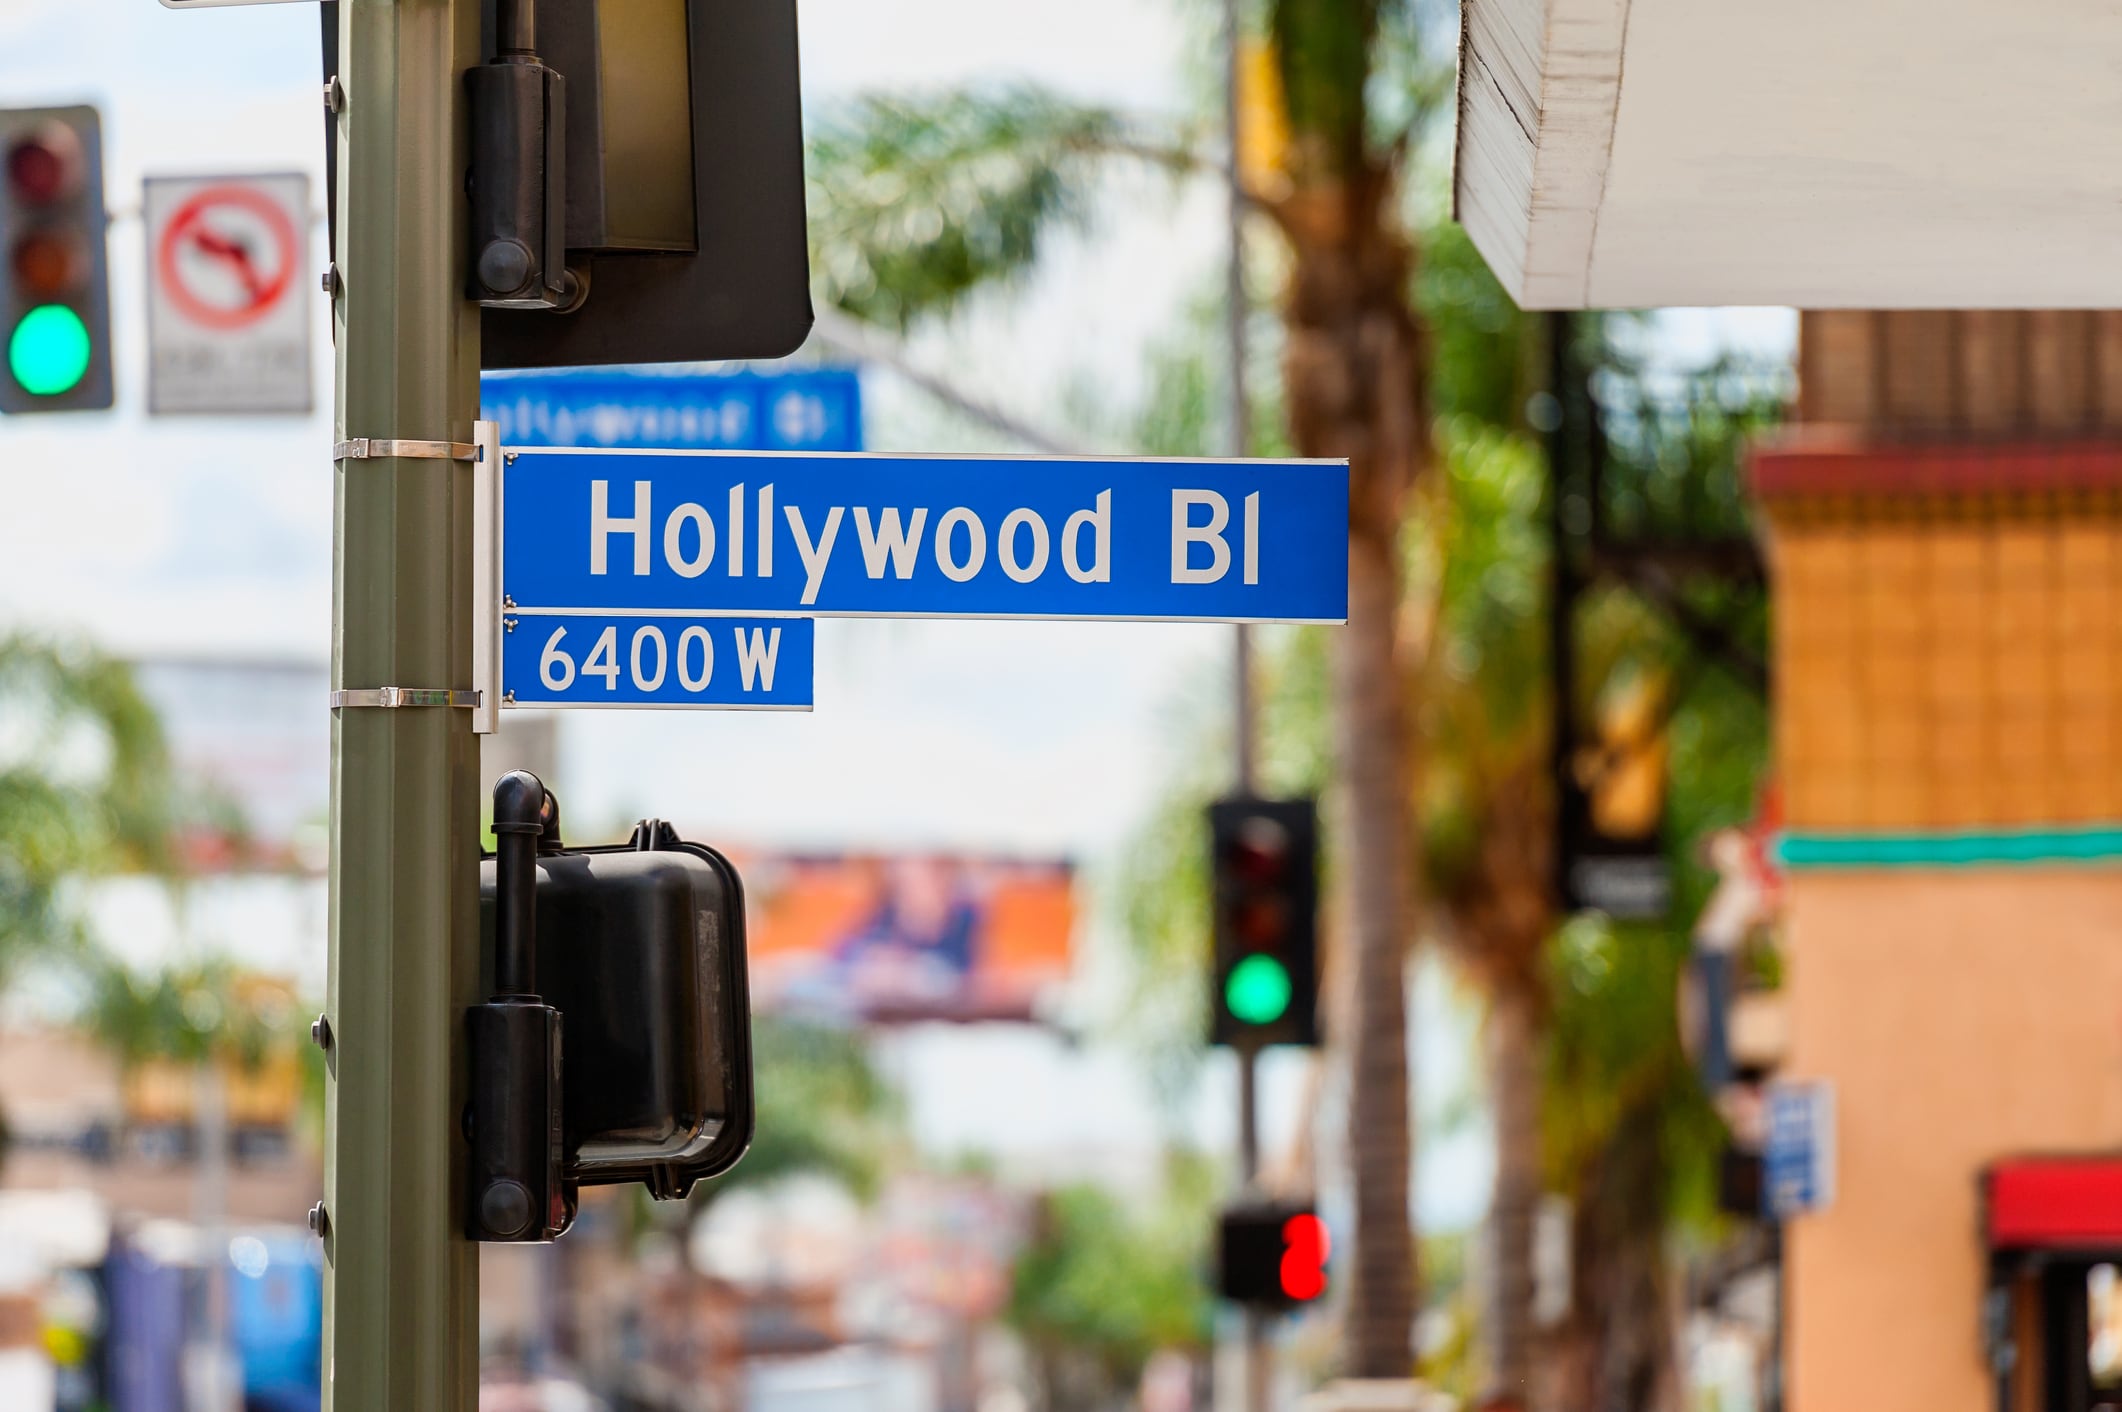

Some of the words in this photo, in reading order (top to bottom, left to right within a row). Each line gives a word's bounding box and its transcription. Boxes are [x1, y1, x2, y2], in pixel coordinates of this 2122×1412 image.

[480, 397, 748, 445] ollywood
[590, 479, 1112, 605] Hollywood
[1170, 488, 1259, 585] Bl
[539, 625, 714, 693] 6400
[734, 627, 782, 692] W
